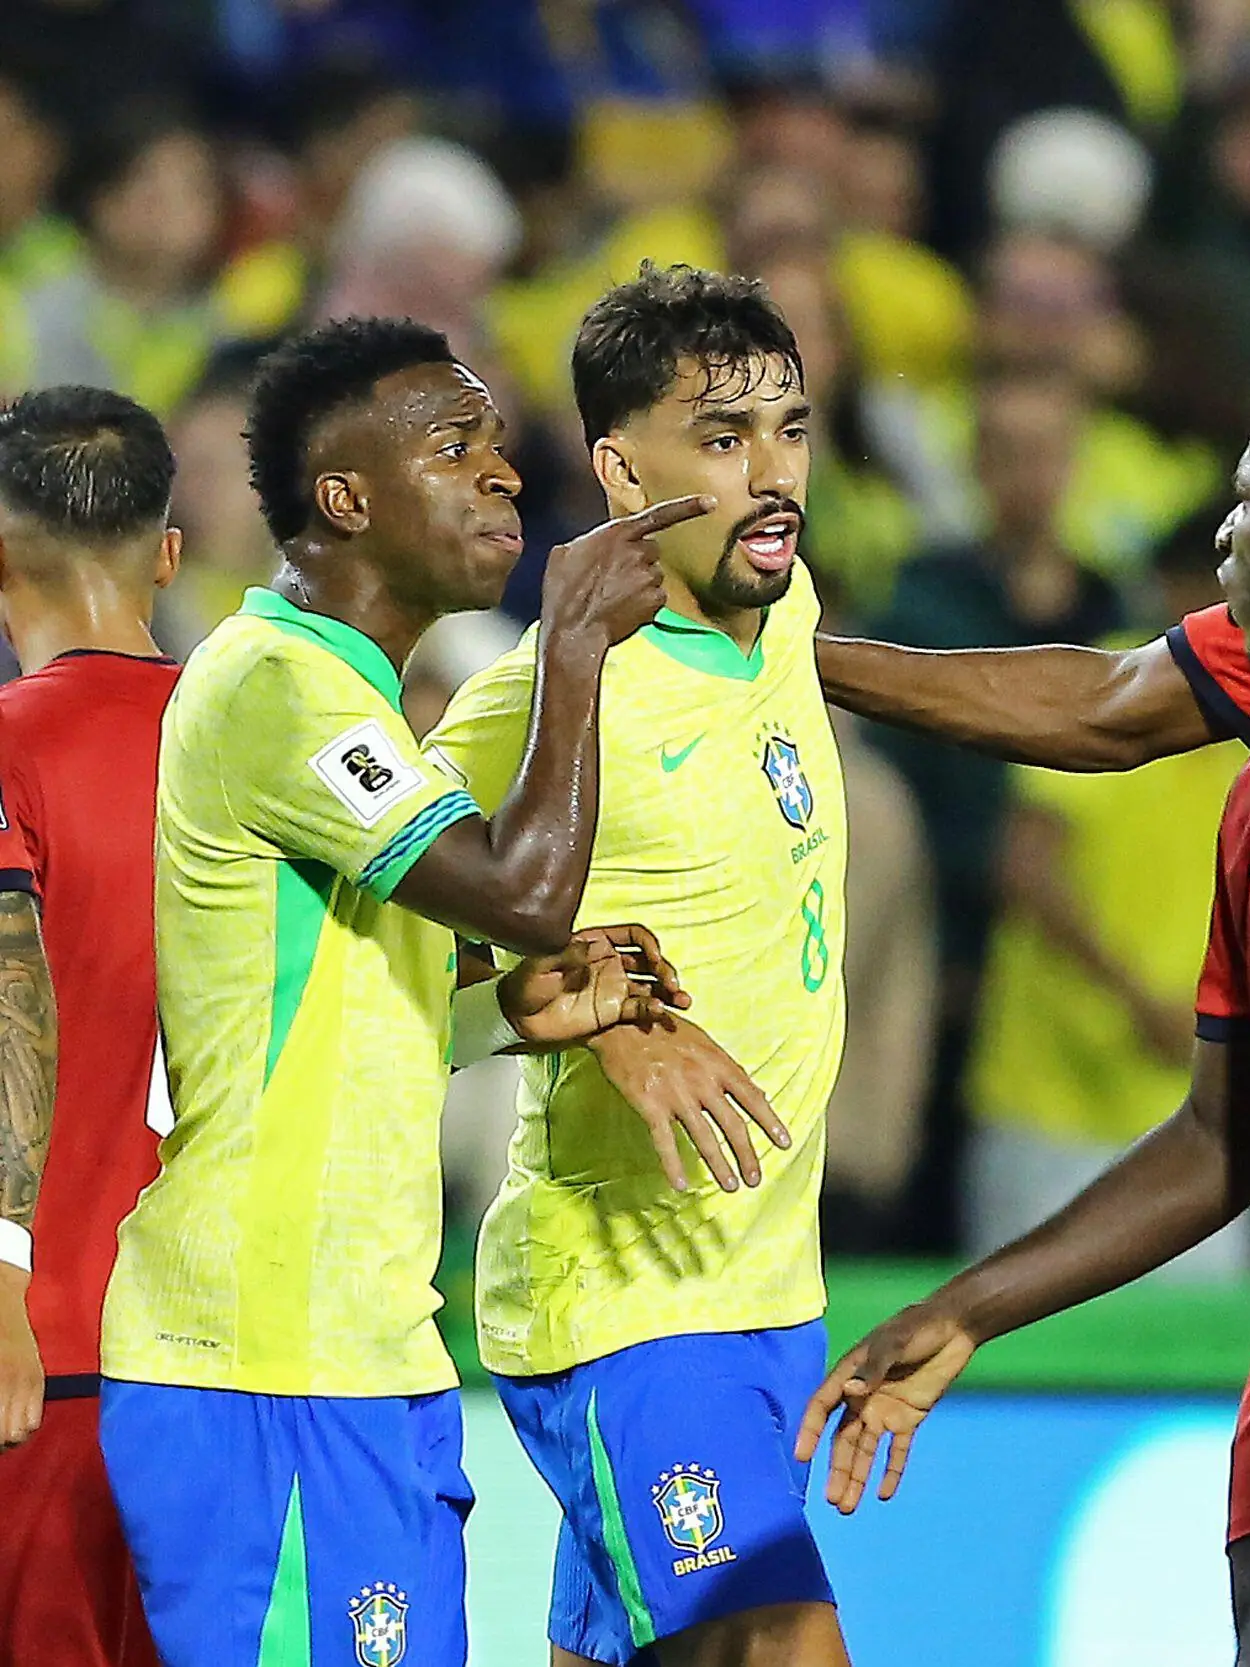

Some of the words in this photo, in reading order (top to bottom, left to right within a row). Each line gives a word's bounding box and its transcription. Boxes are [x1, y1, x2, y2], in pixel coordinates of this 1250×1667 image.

[791, 827, 829, 864] BRASIL
[801, 878, 828, 993] 8
[677, 1504, 700, 1517] CBF
[673, 1546, 737, 1576] BRASIL
